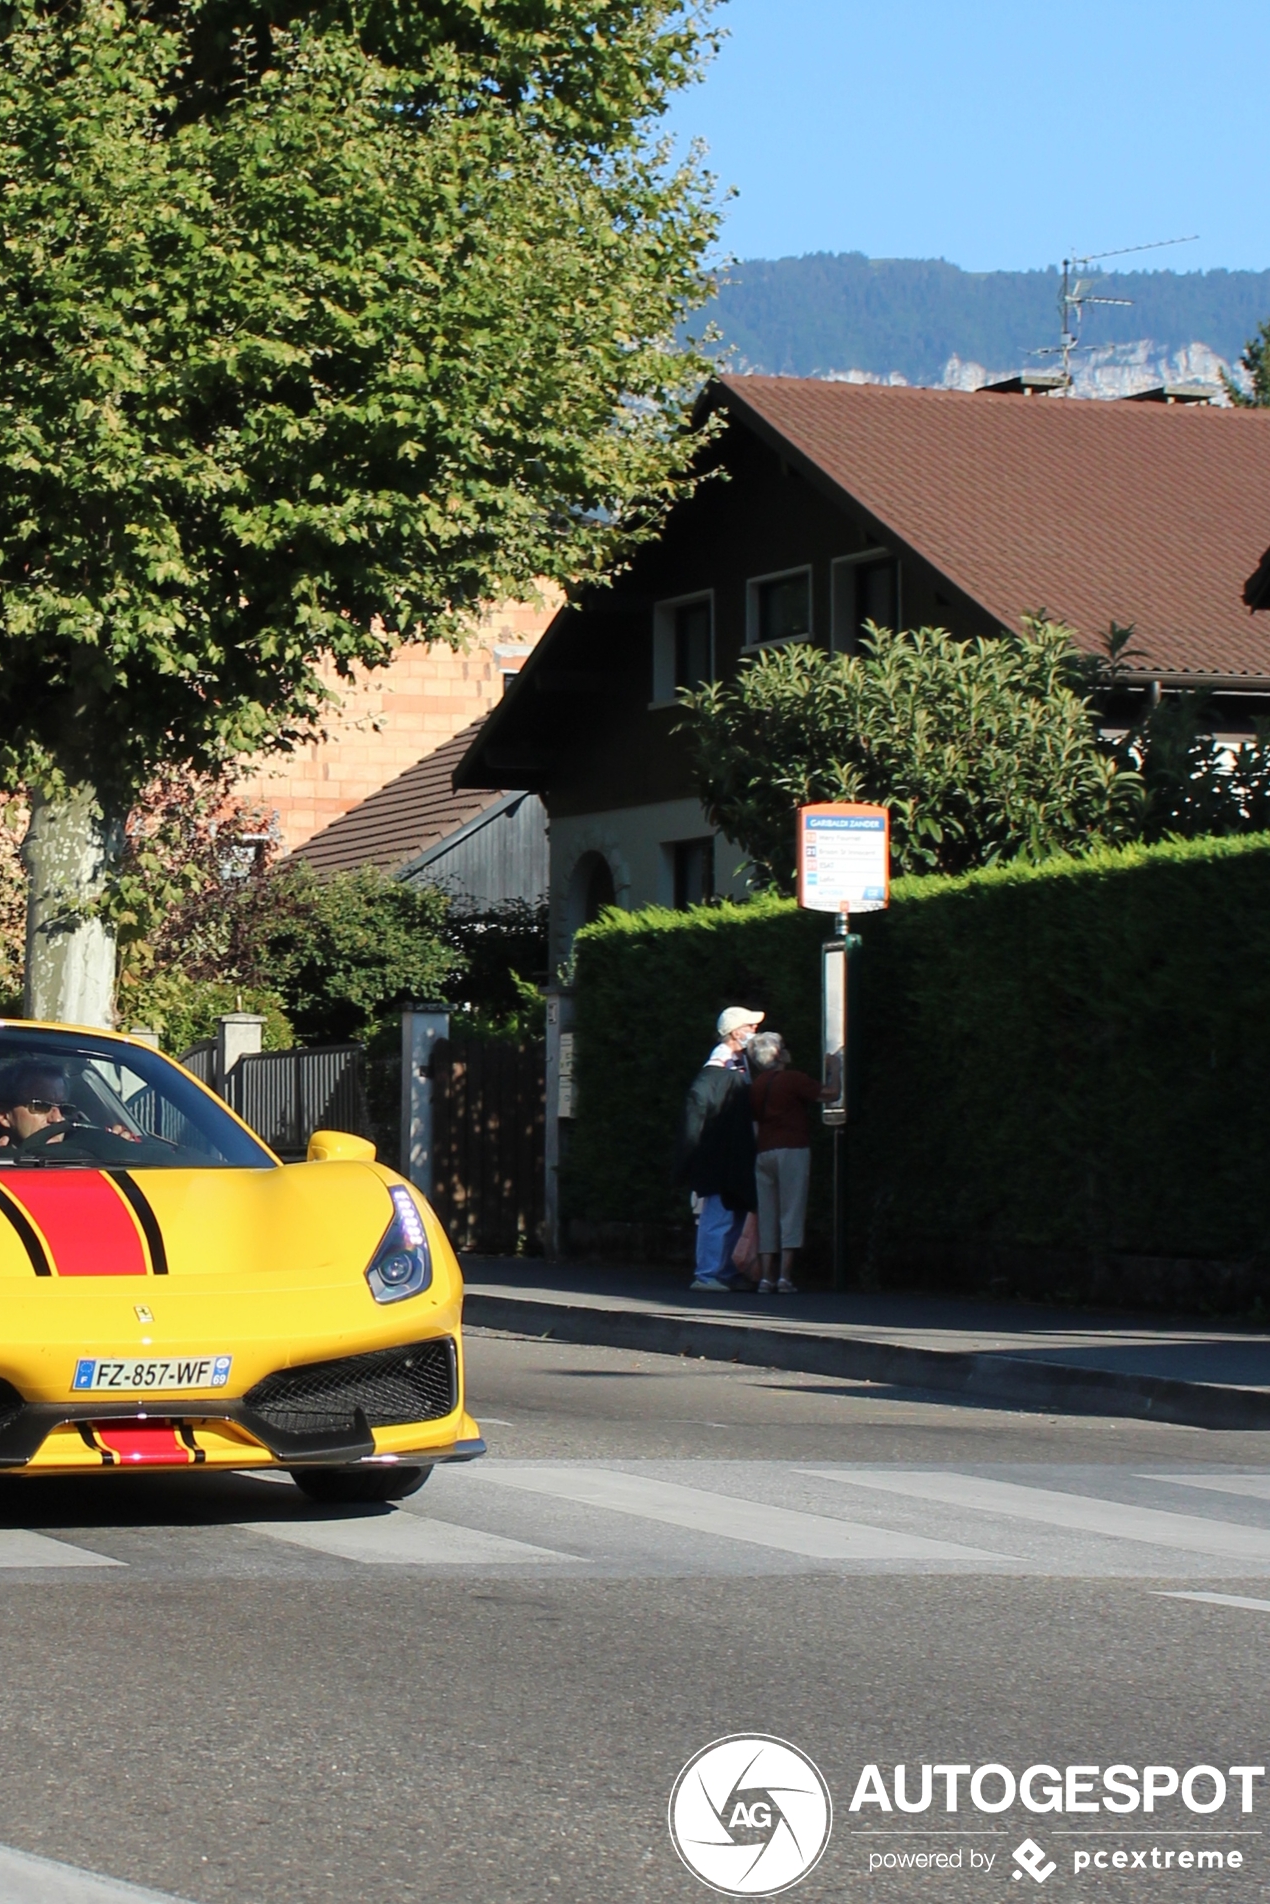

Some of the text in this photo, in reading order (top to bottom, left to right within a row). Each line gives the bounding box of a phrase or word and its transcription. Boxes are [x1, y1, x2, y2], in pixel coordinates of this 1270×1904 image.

[810, 819, 879, 829] GARIBALDI ZANDER
[96, 1361, 211, 1387] FZ-857-WF
[80, 1376, 88, 1384] F
[213, 1374, 226, 1385] 69
